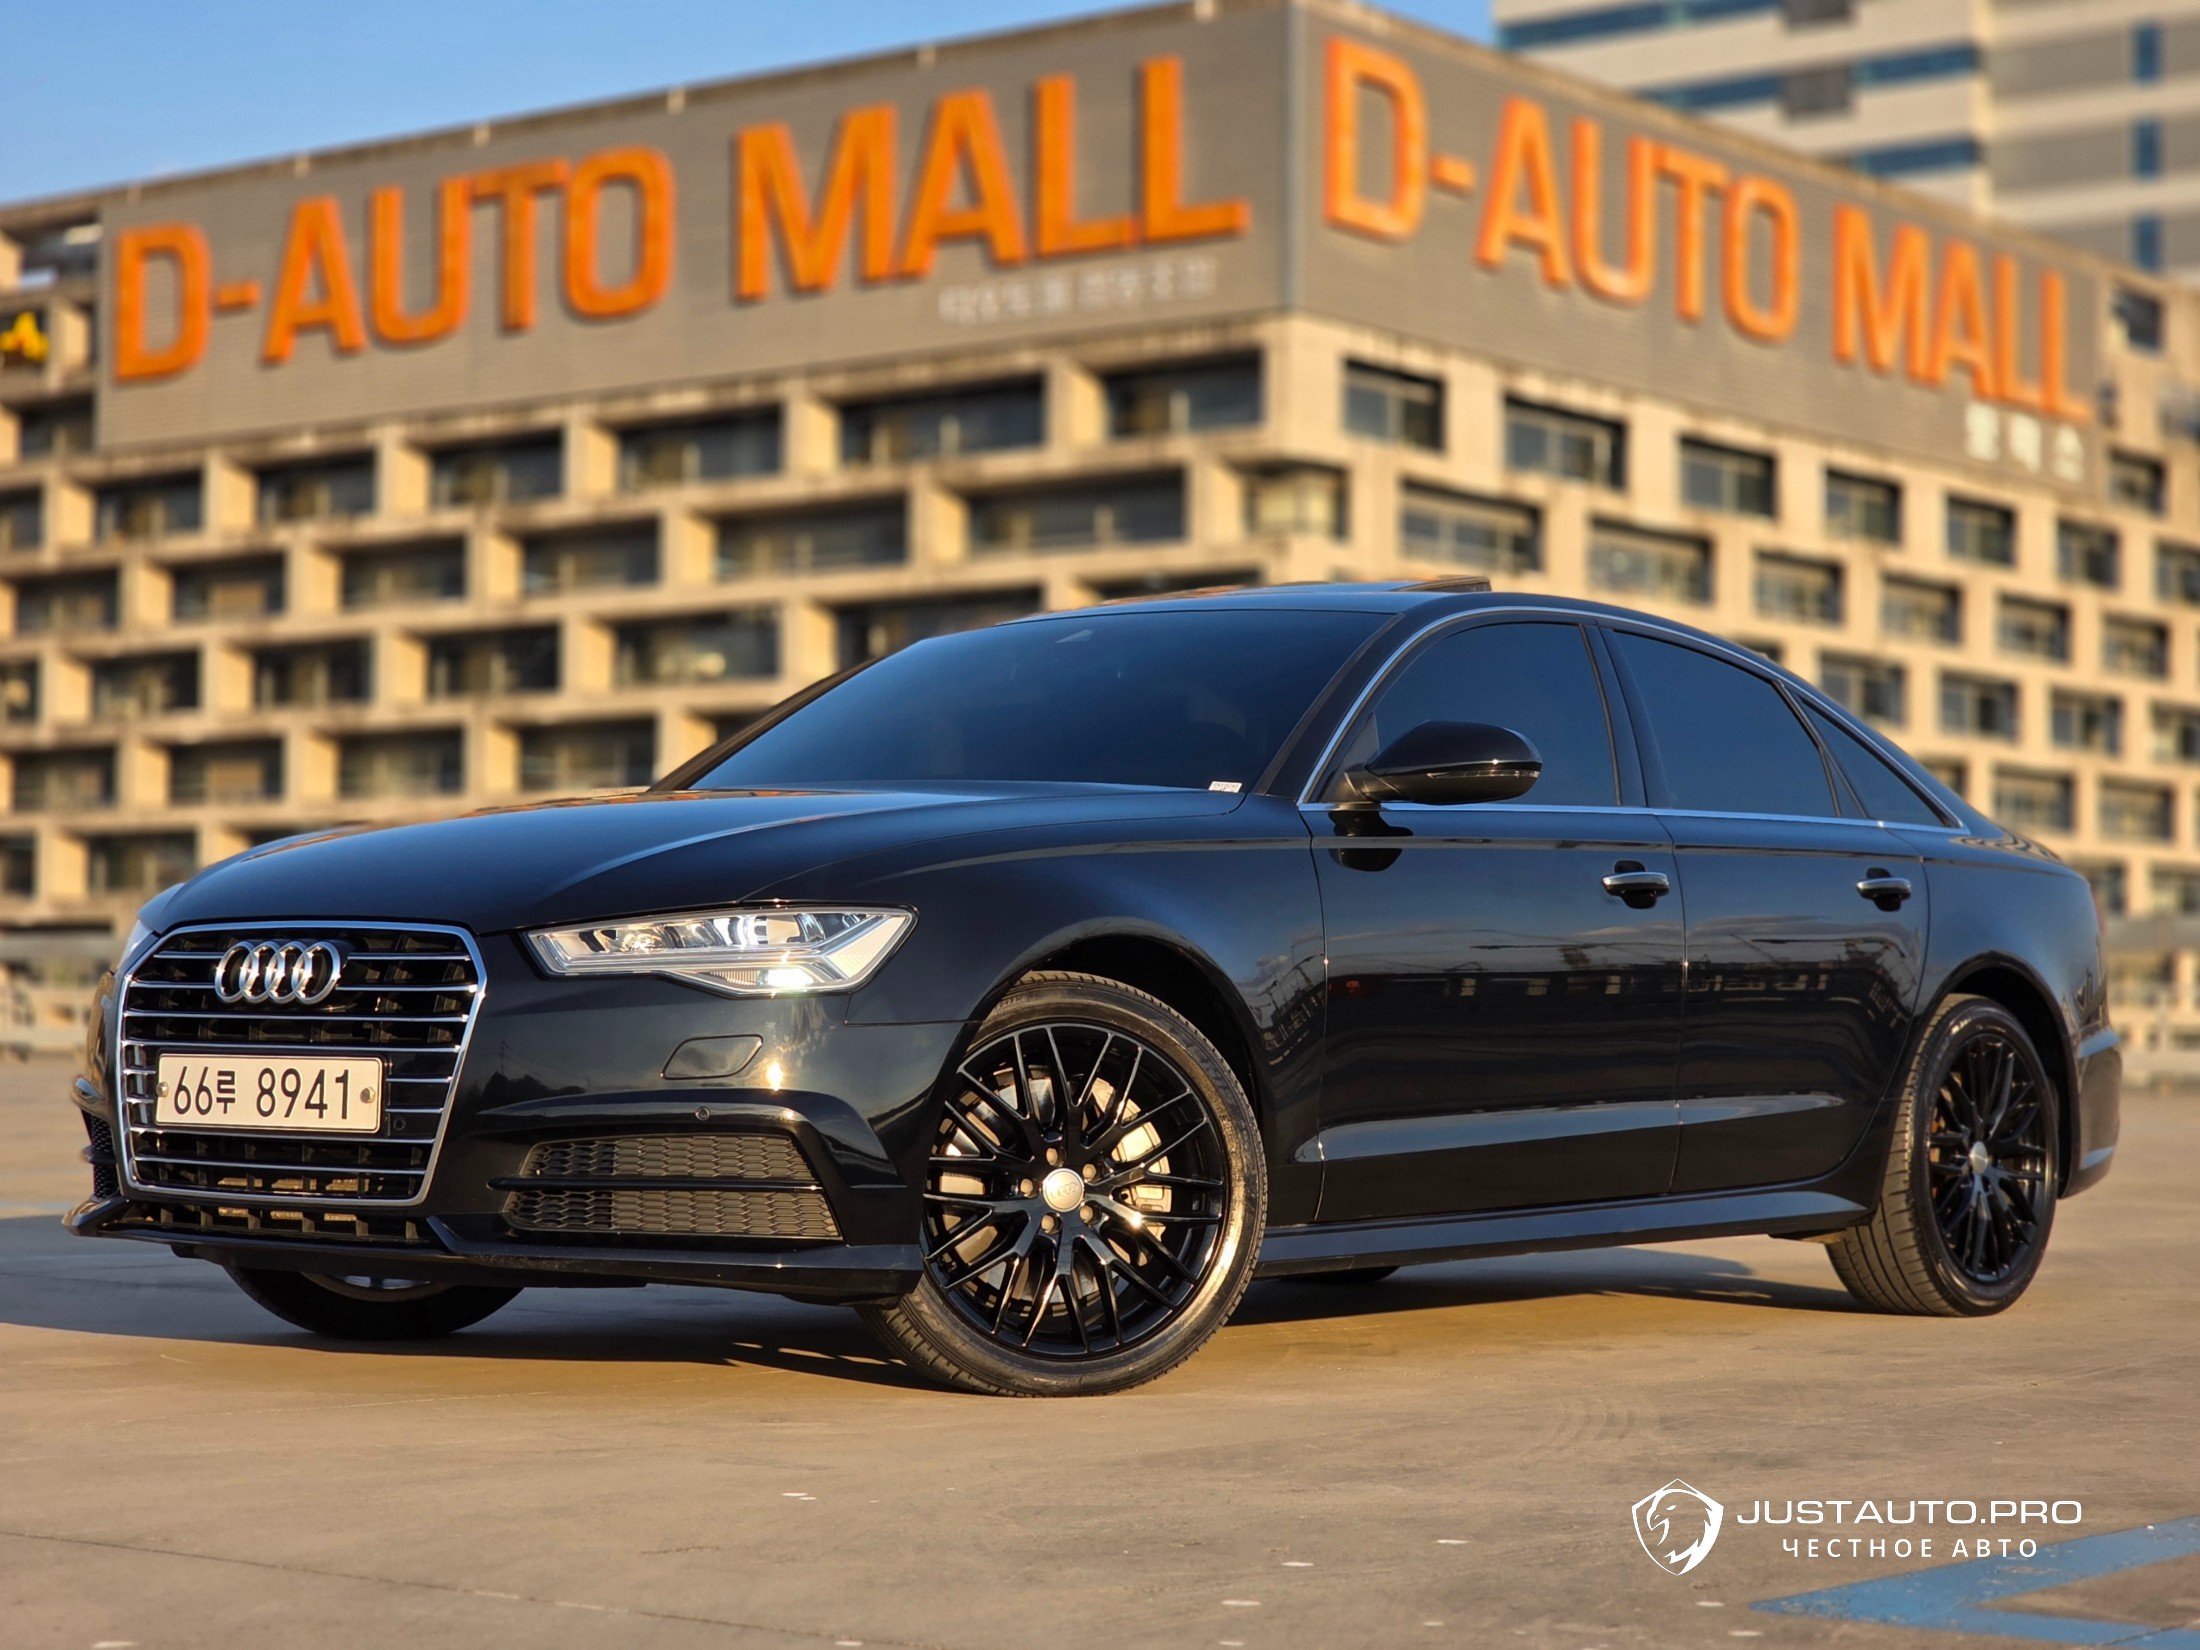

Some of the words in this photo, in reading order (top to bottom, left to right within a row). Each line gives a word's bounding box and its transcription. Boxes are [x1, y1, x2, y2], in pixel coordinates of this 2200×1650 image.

[113, 144, 677, 384] D-AUTO
[734, 55, 1250, 303] MALL
[1323, 36, 1802, 346] D-AUTO
[1830, 202, 2096, 424] MALL
[174, 1065, 236, 1116] 66루
[256, 1067, 350, 1120] 8941
